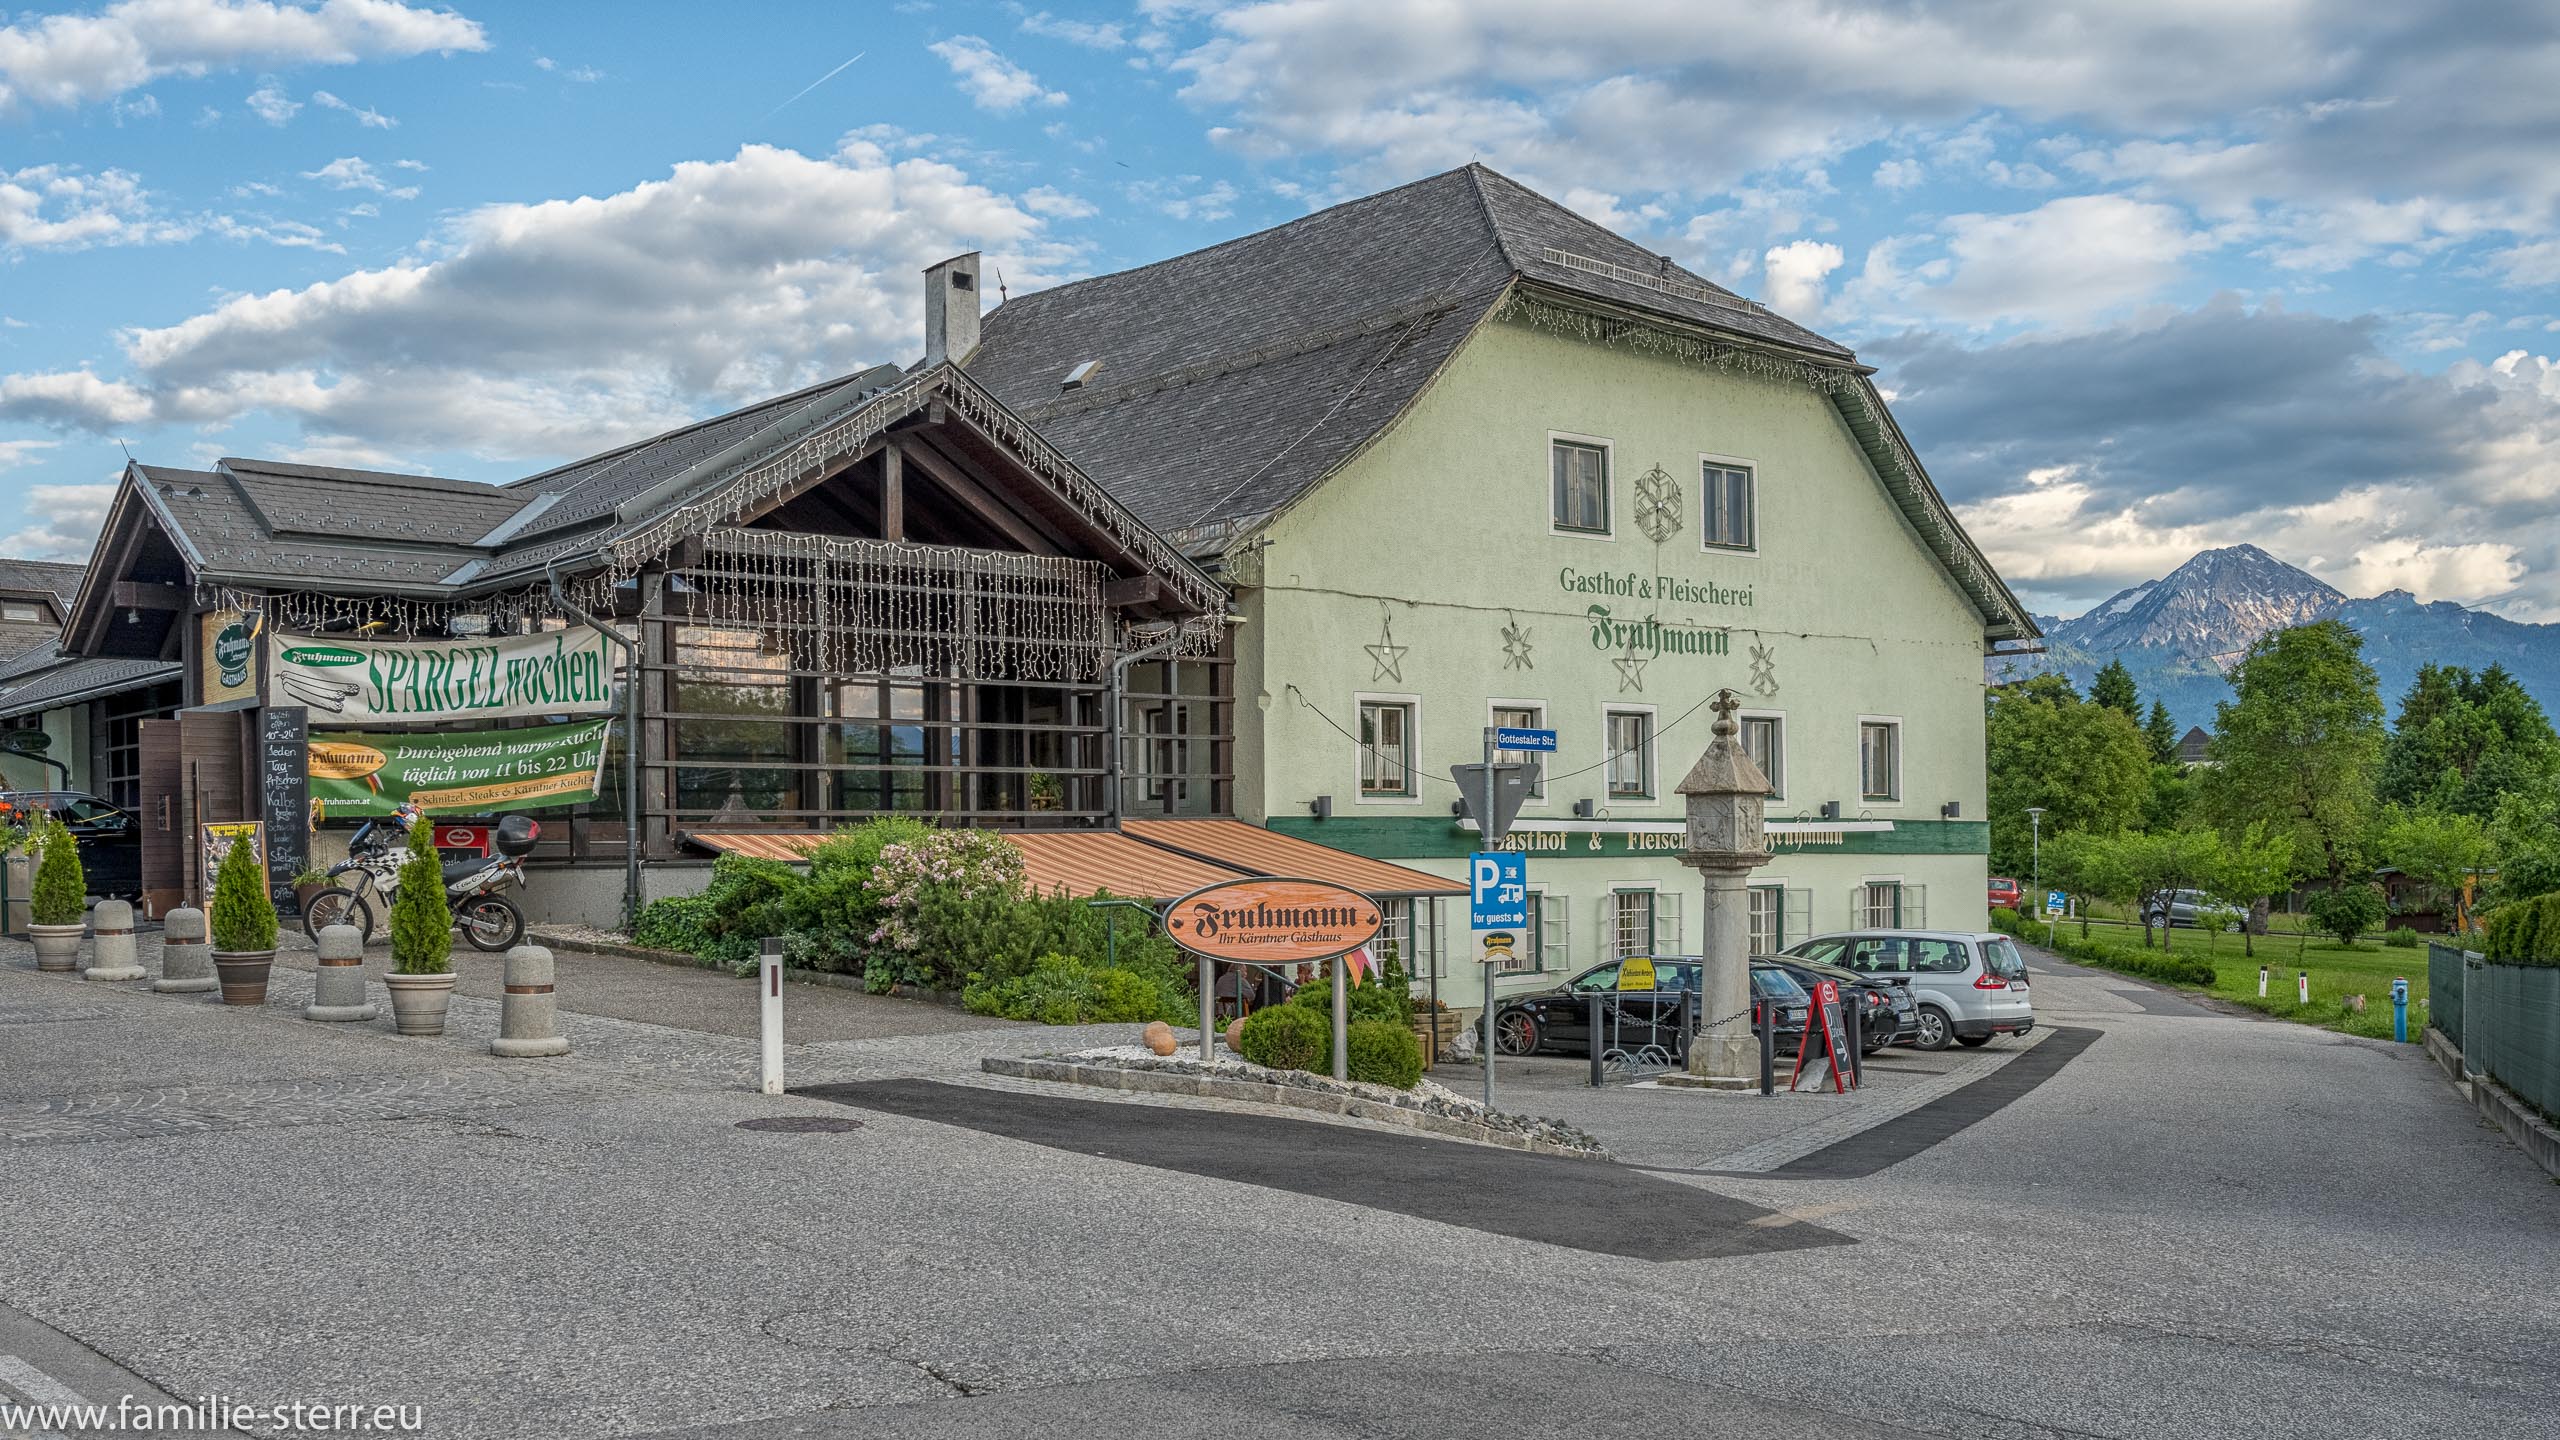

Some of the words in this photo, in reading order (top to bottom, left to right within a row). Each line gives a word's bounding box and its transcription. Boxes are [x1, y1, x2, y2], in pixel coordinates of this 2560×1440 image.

[1559, 567, 1636, 597] Gasthof
[1638, 580, 1652, 599] &
[1656, 576, 1754, 607] Fleischerei
[1587, 604, 1729, 660] Fruhmann
[291, 651, 358, 664] Fruhmann
[221, 668, 247, 686] GASTHAUS
[1499, 733, 1541, 745] Gottestaler
[1542, 736, 1555, 746] Str.
[396, 741, 502, 763] Durchgehend
[403, 766, 456, 786] täglich
[462, 767, 489, 779] von
[495, 762, 511, 778] 11
[517, 759, 541, 776] bis
[546, 757, 567, 773] 22
[469, 788, 500, 801] Steaks
[514, 781, 558, 796] Kärntner
[320, 798, 370, 806] .fruhmann.at
[1498, 831, 1569, 850] asthof
[1588, 832, 1603, 850] &
[1626, 832, 1688, 850] Fleisch
[1475, 859, 1500, 905] P
[1193, 901, 1358, 938] Fruhmann
[1473, 912, 1485, 923] for
[1486, 913, 1512, 925] guests
[1218, 932, 1237, 944] Ihr
[1238, 932, 1289, 944] Kärntner
